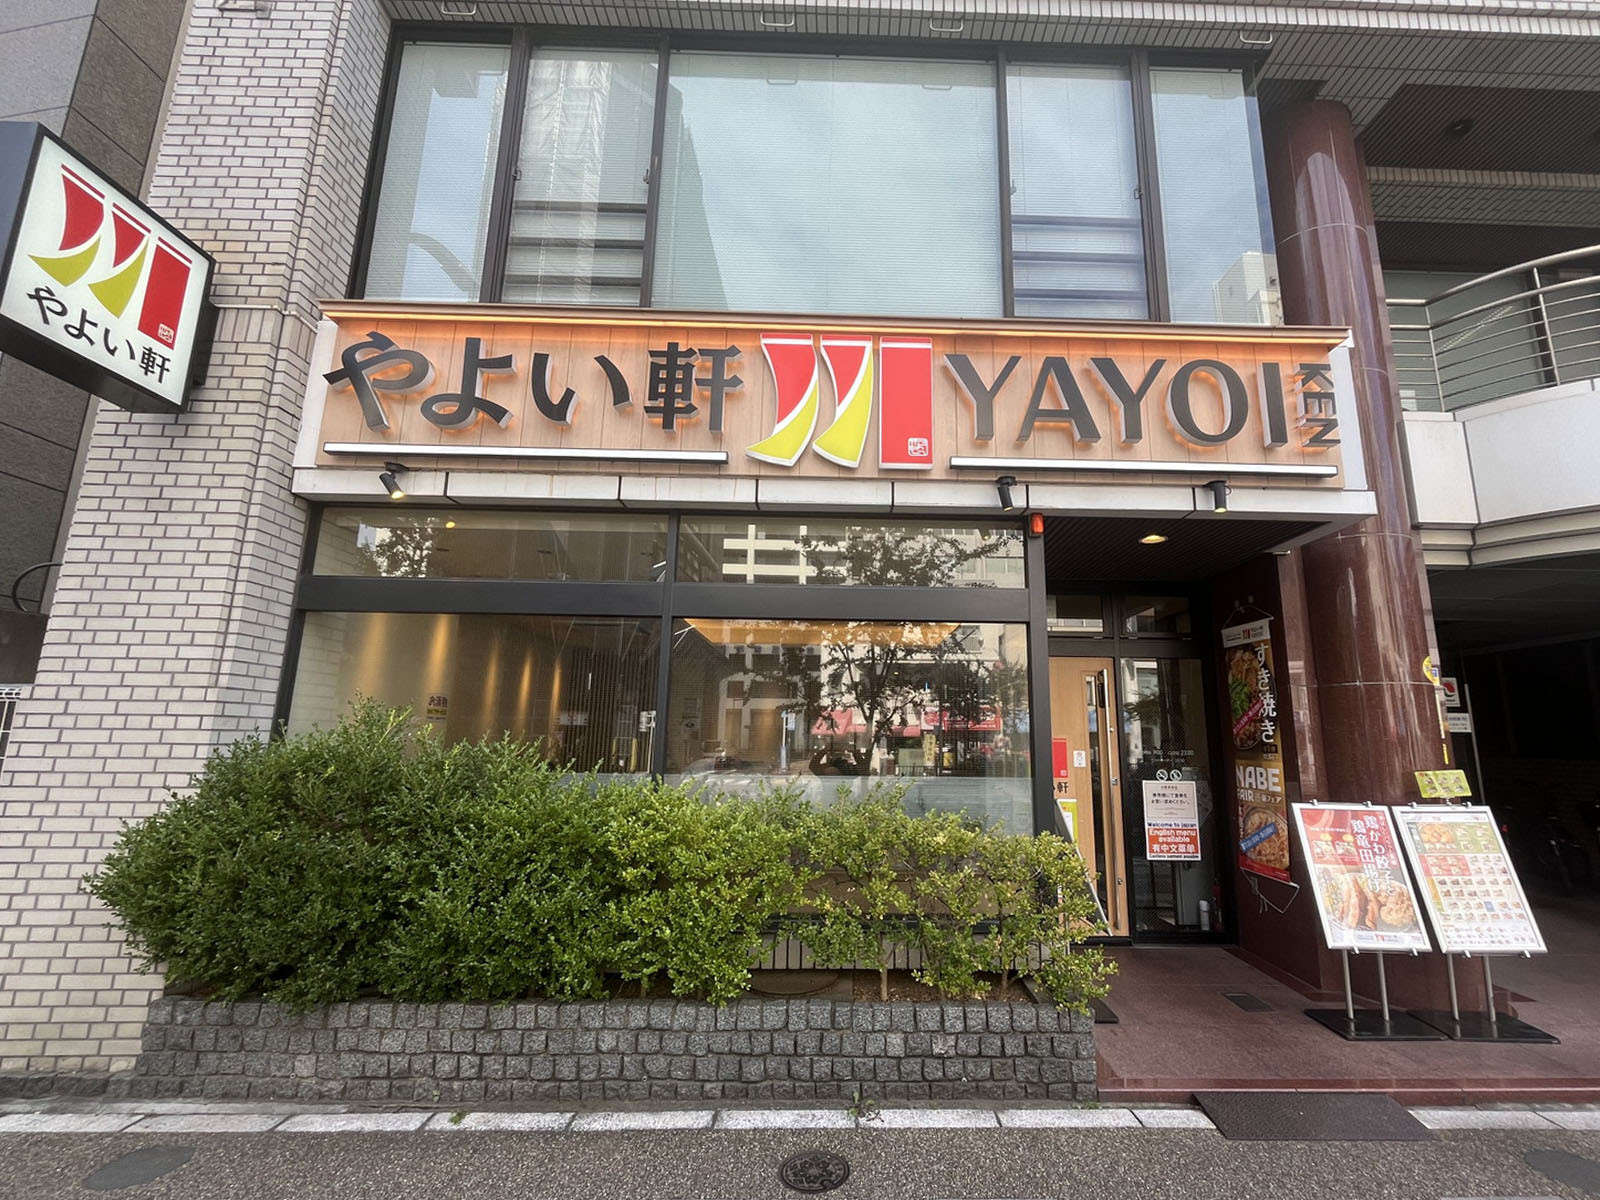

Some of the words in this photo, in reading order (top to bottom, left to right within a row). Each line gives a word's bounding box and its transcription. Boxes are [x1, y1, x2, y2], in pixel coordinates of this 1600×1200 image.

[27, 286, 171, 384] やよい軒
[322, 331, 744, 433] やよい軒
[944, 353, 1289, 449] YAYOI
[1297, 363, 1341, 447] KEN
[1255, 642, 1277, 743] すき焼き
[1236, 765, 1282, 792] NABE
